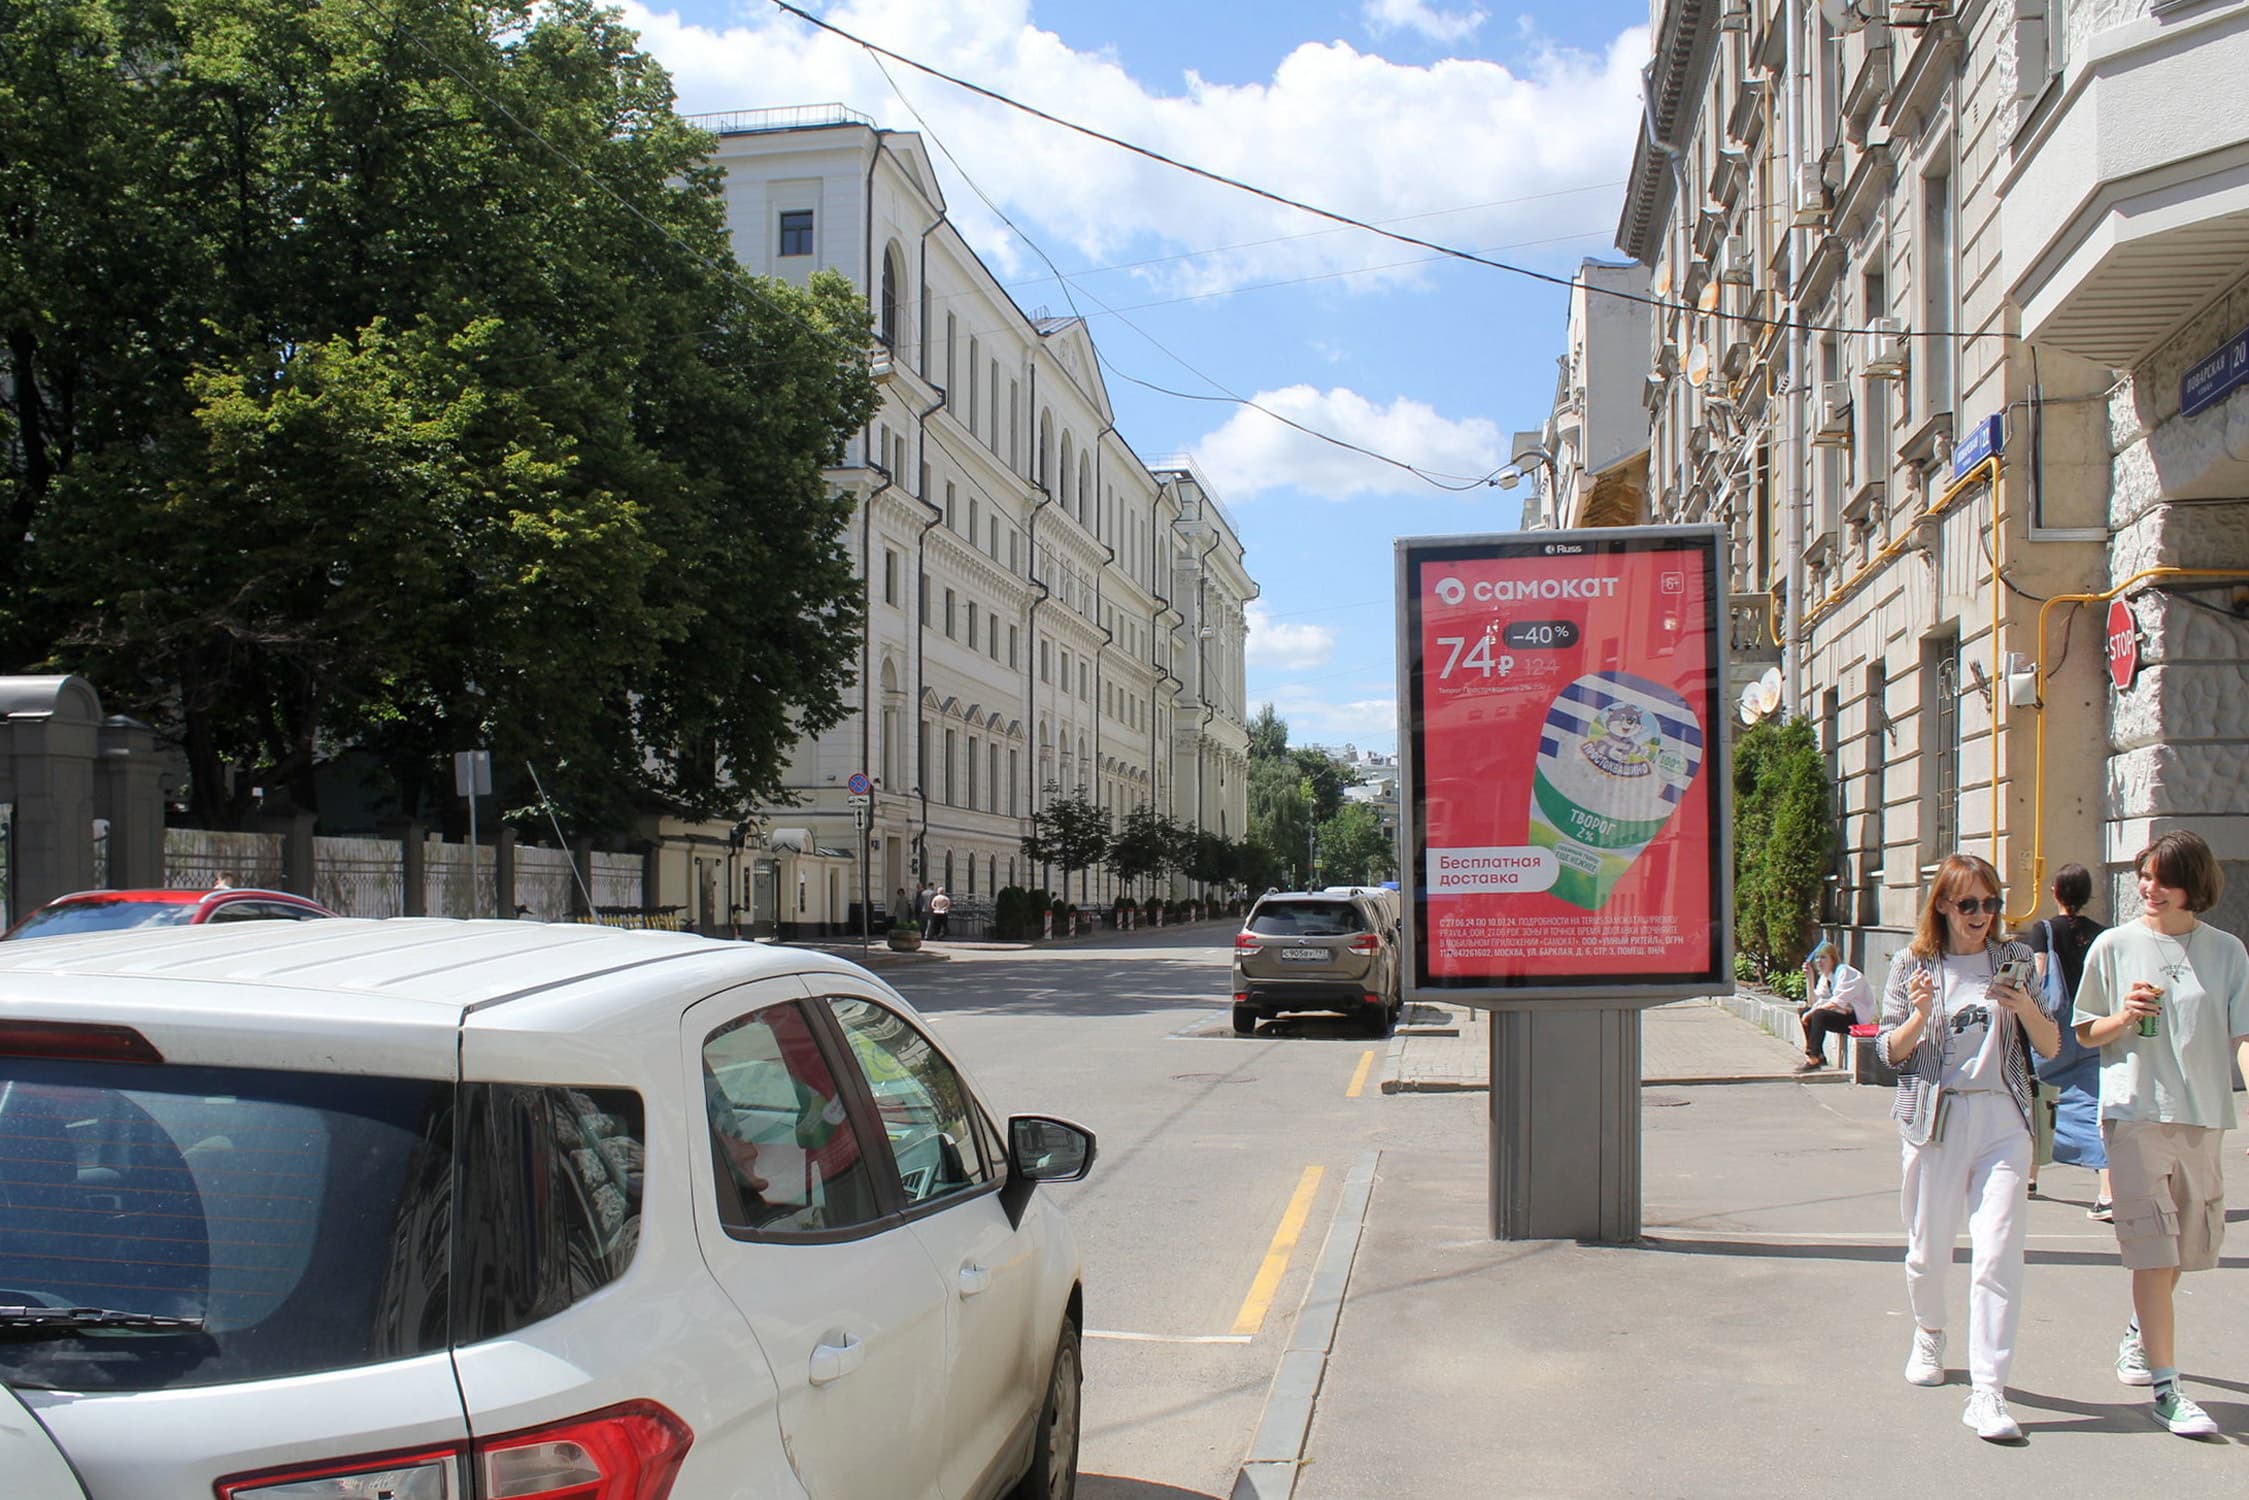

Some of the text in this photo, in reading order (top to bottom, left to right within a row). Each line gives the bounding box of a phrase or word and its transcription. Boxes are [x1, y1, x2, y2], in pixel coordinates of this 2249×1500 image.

[2233, 341, 2247, 368] 20
[1556, 544, 1583, 554] Russ
[1473, 576, 1619, 602] самокат
[2109, 630, 2132, 661] STOP
[1571, 808, 1616, 836] ТВОРОГ
[1440, 855, 1541, 870] Бесплатная
[1440, 872, 1519, 887] доставка
